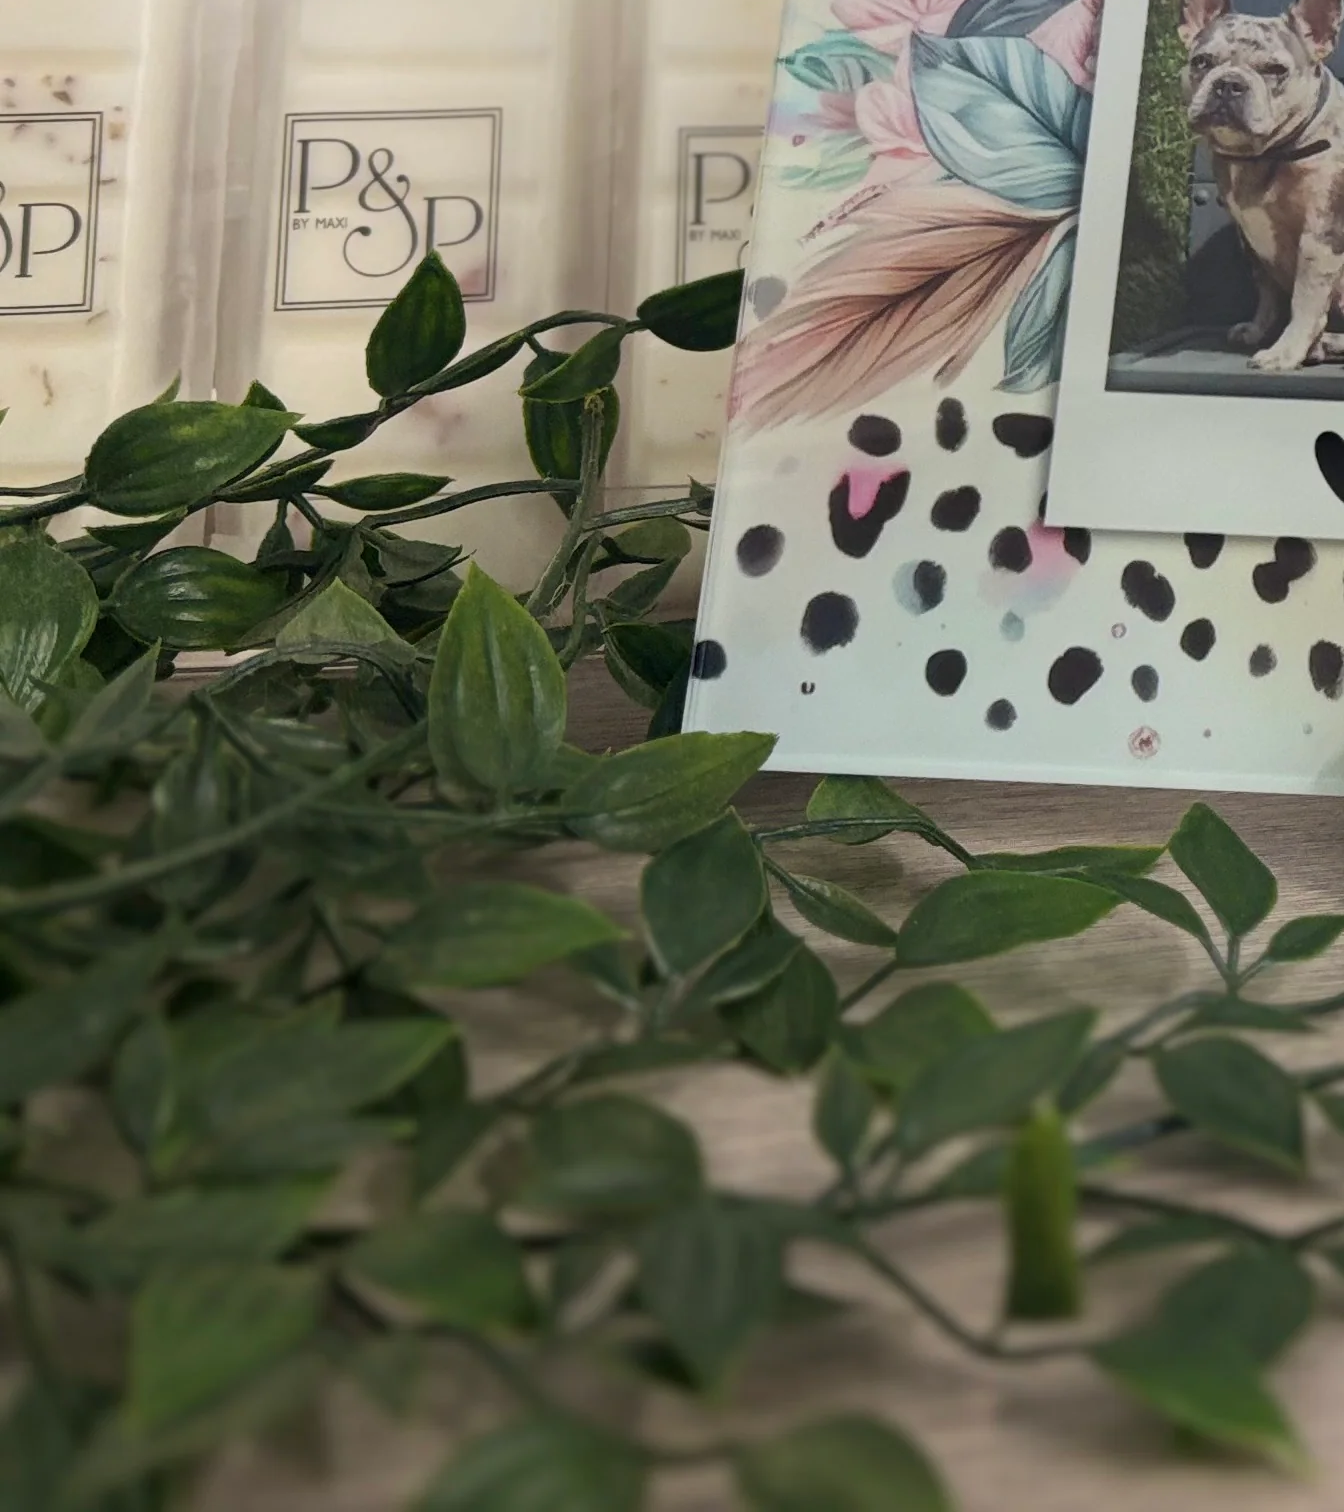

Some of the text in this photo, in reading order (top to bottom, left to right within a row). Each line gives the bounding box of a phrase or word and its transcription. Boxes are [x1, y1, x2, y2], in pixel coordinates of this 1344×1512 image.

[292, 217, 348, 231] BY MAXI
[294, 138, 483, 277] P&P
